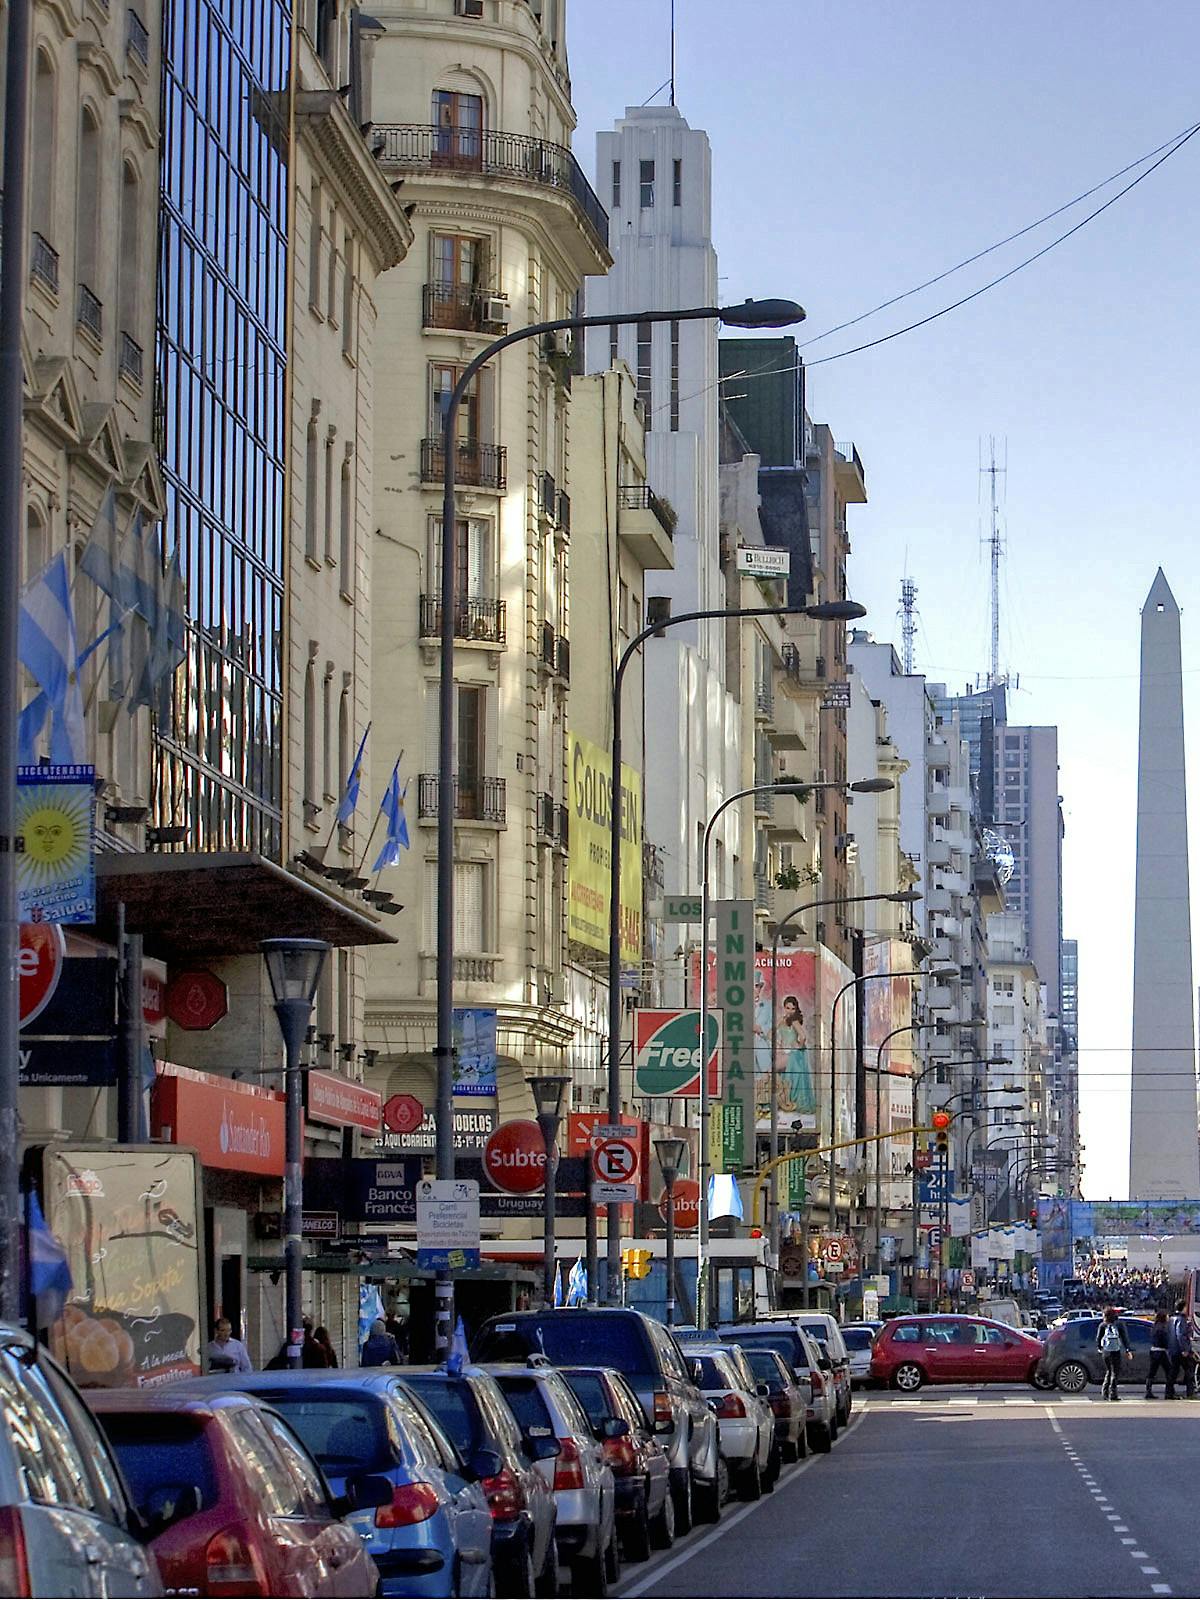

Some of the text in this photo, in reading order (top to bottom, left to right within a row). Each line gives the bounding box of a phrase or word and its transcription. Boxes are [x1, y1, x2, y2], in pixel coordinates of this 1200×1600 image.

[18, 766, 95, 775] BICENTENARIO
[573, 741, 638, 846] GOLDSEIN
[669, 903, 701, 916] LOS
[754, 957, 792, 967] ACHNO
[641, 1041, 702, 1067] Free
[385, 1134, 401, 1148] AQUI
[401, 1134, 437, 1148] CORRIENT
[368, 1187, 412, 1201] Banco
[364, 1201, 416, 1214] Francés
[498, 1199, 544, 1209] Uruguay
[664, 1197, 700, 1212] ubte
[300, 1221, 334, 1231] ANELCO
